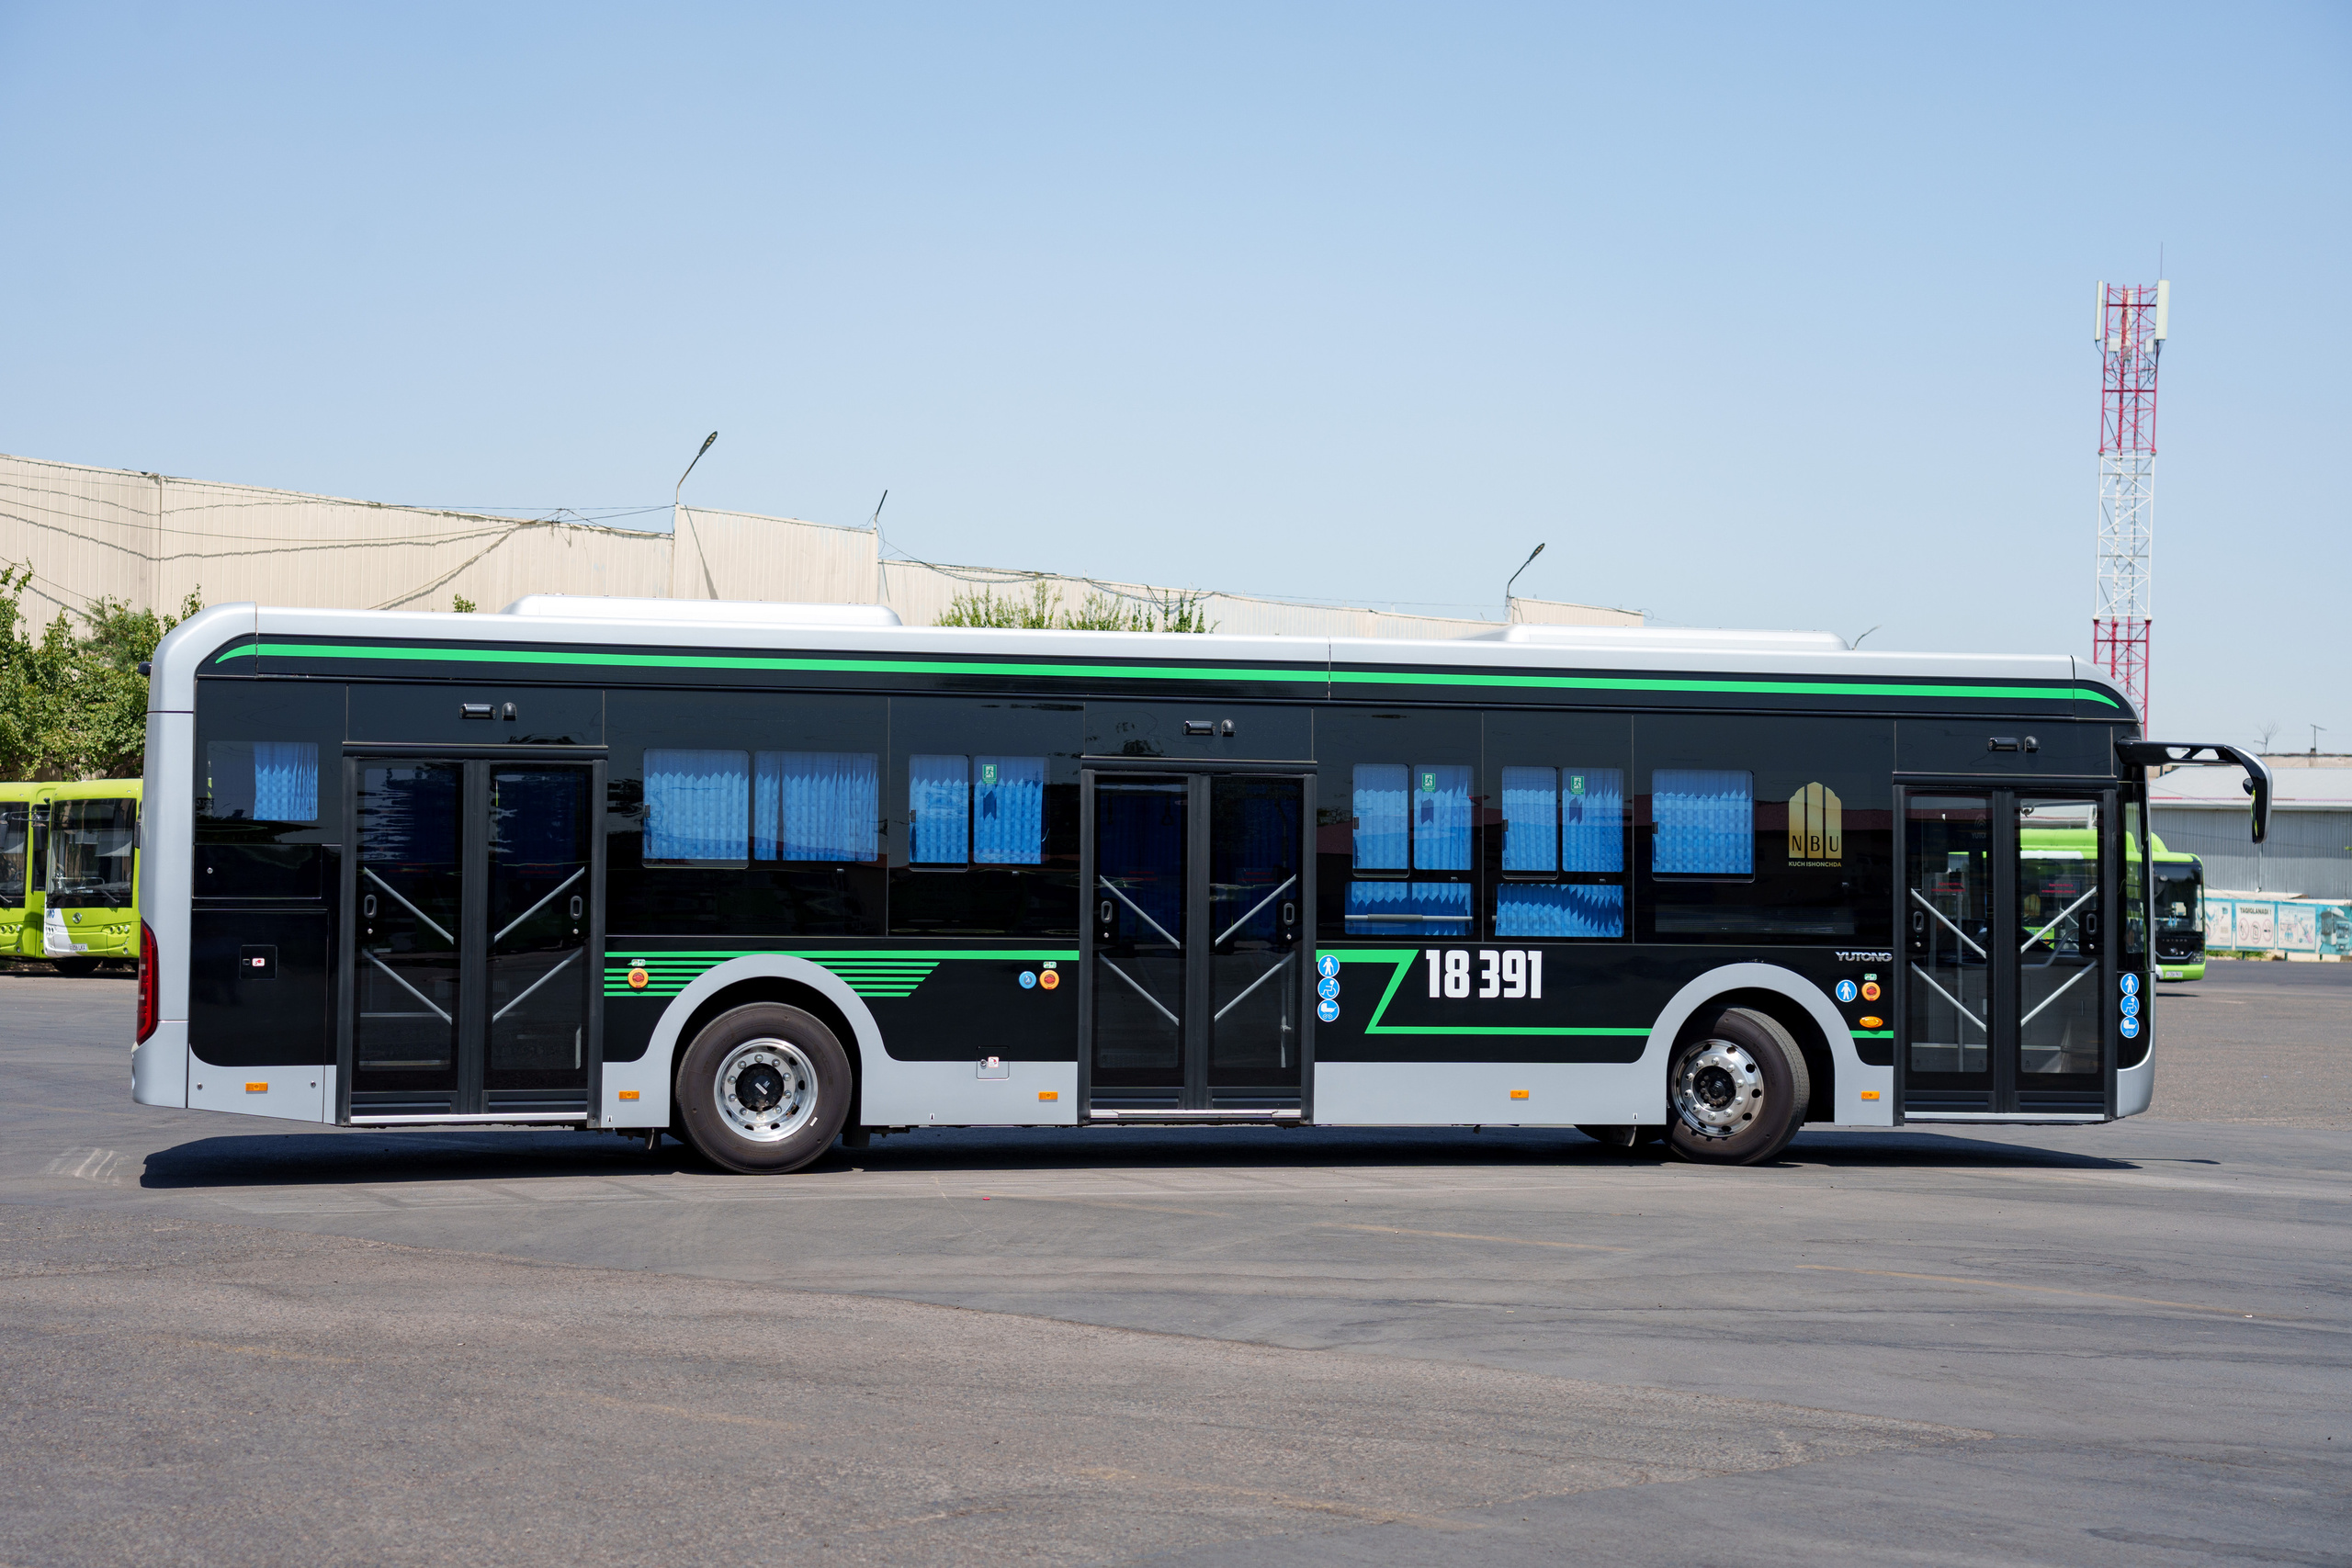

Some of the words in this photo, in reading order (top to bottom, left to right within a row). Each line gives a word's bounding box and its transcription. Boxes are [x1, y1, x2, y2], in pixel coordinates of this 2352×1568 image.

[1792, 835, 1839, 852] NBU
[1835, 951, 1894, 962] YUTONG
[1425, 949, 1470, 998] 18
[1478, 950, 1543, 999] 391
